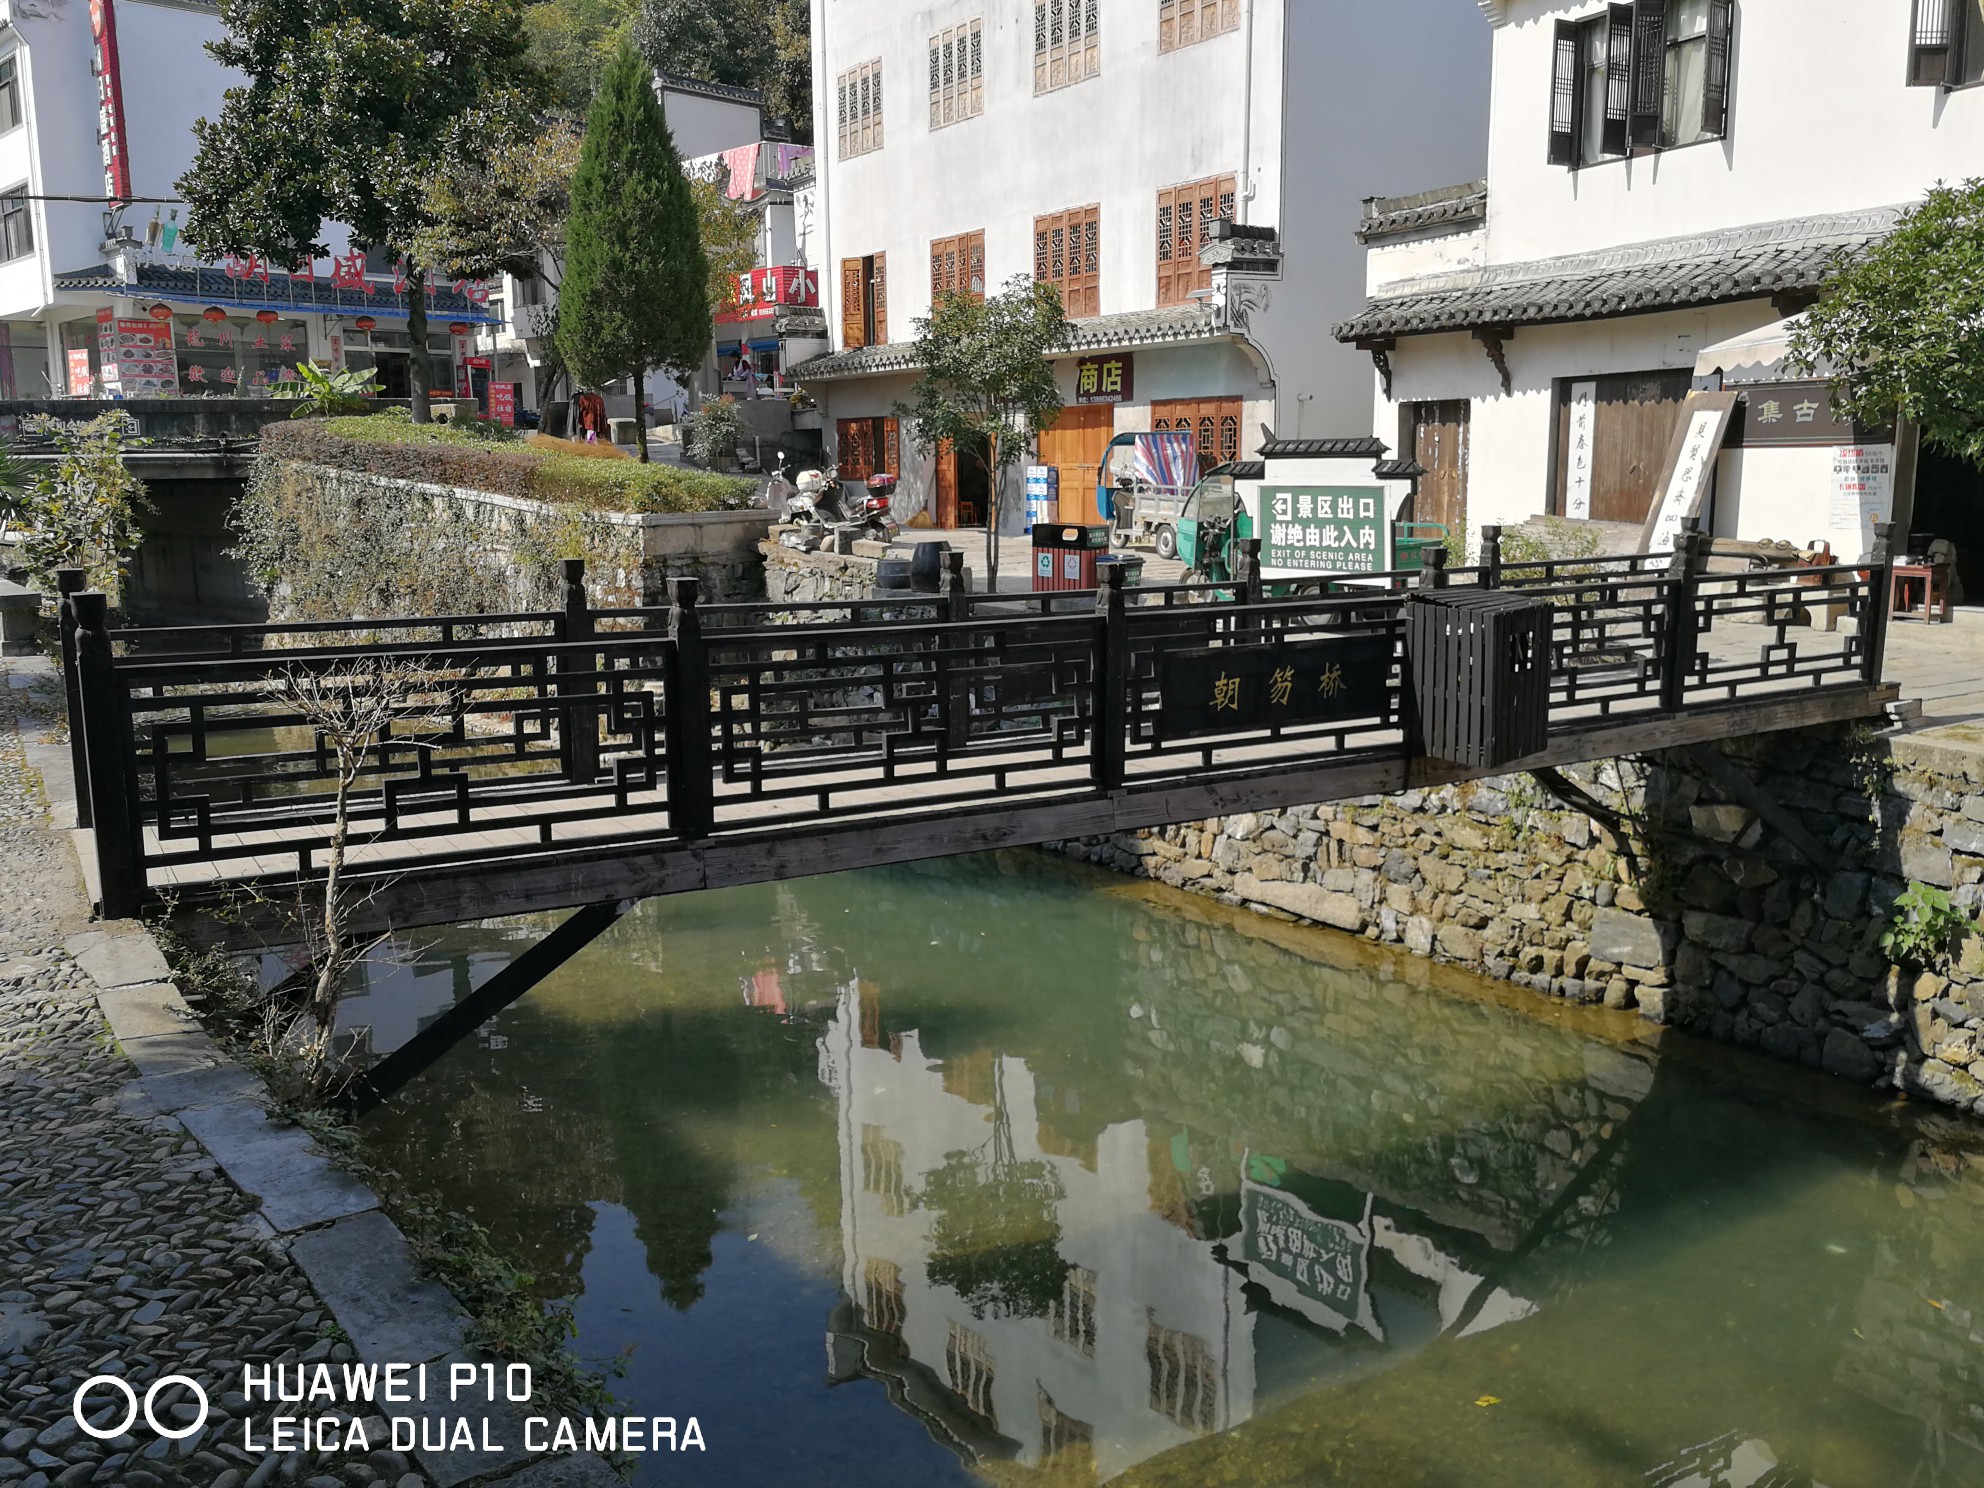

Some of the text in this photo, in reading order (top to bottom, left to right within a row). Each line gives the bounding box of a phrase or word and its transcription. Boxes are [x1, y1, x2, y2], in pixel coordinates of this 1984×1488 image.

[1080, 360, 1122, 394] 商店
[1297, 495, 1374, 519] 景区出口
[1270, 523, 1375, 549] 谢绝由此入内
[1271, 549, 1373, 562] EXIT OF SCENIC AREA
[1271, 558, 1373, 571] NO ENTERING PLEASE
[1209, 662, 1347, 711] 朝笏桥
